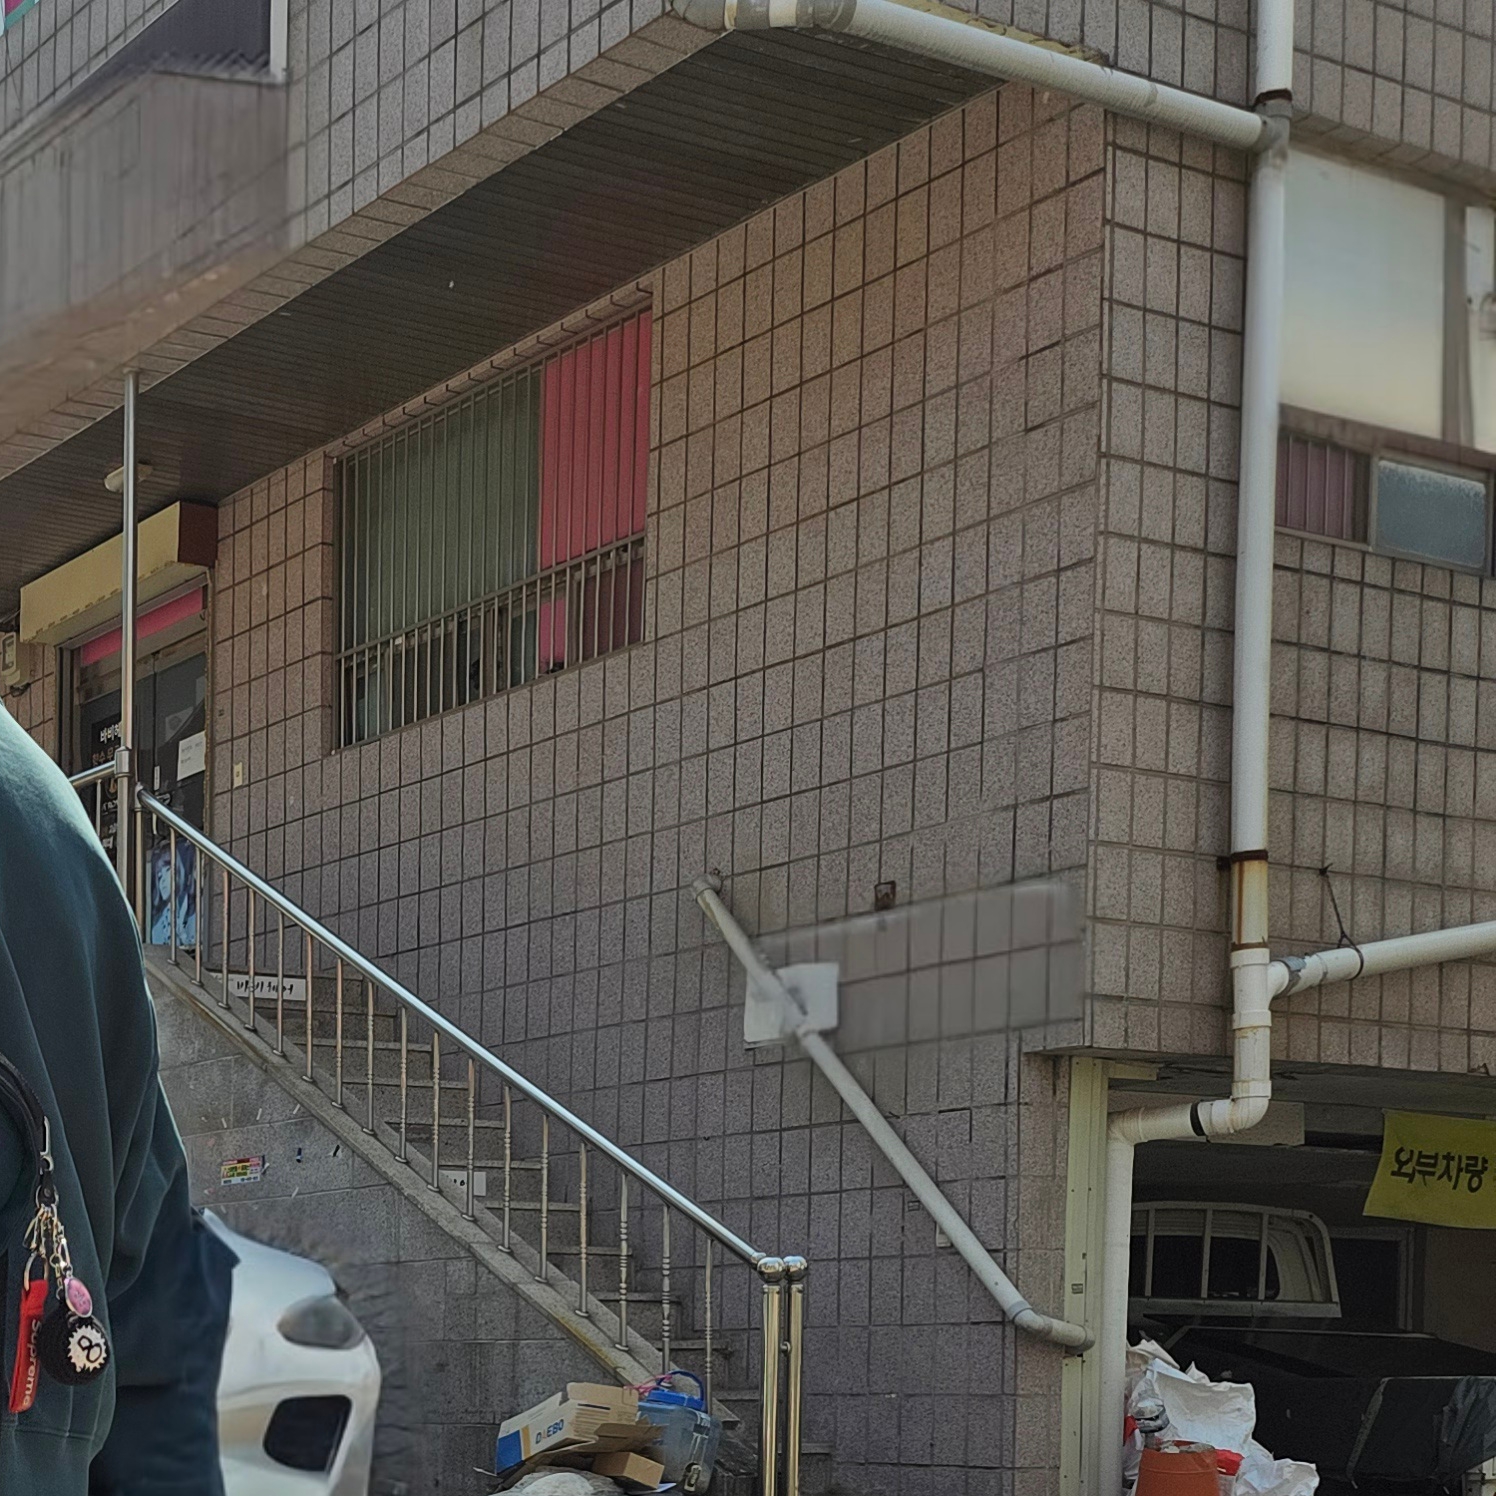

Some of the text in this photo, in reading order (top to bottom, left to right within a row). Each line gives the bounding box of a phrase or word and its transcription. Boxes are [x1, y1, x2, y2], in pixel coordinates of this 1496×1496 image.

[1390, 1146, 1489, 1193] 외부차량
[22, 1319, 42, 1405] Supreme
[77, 1335, 102, 1363] 8
